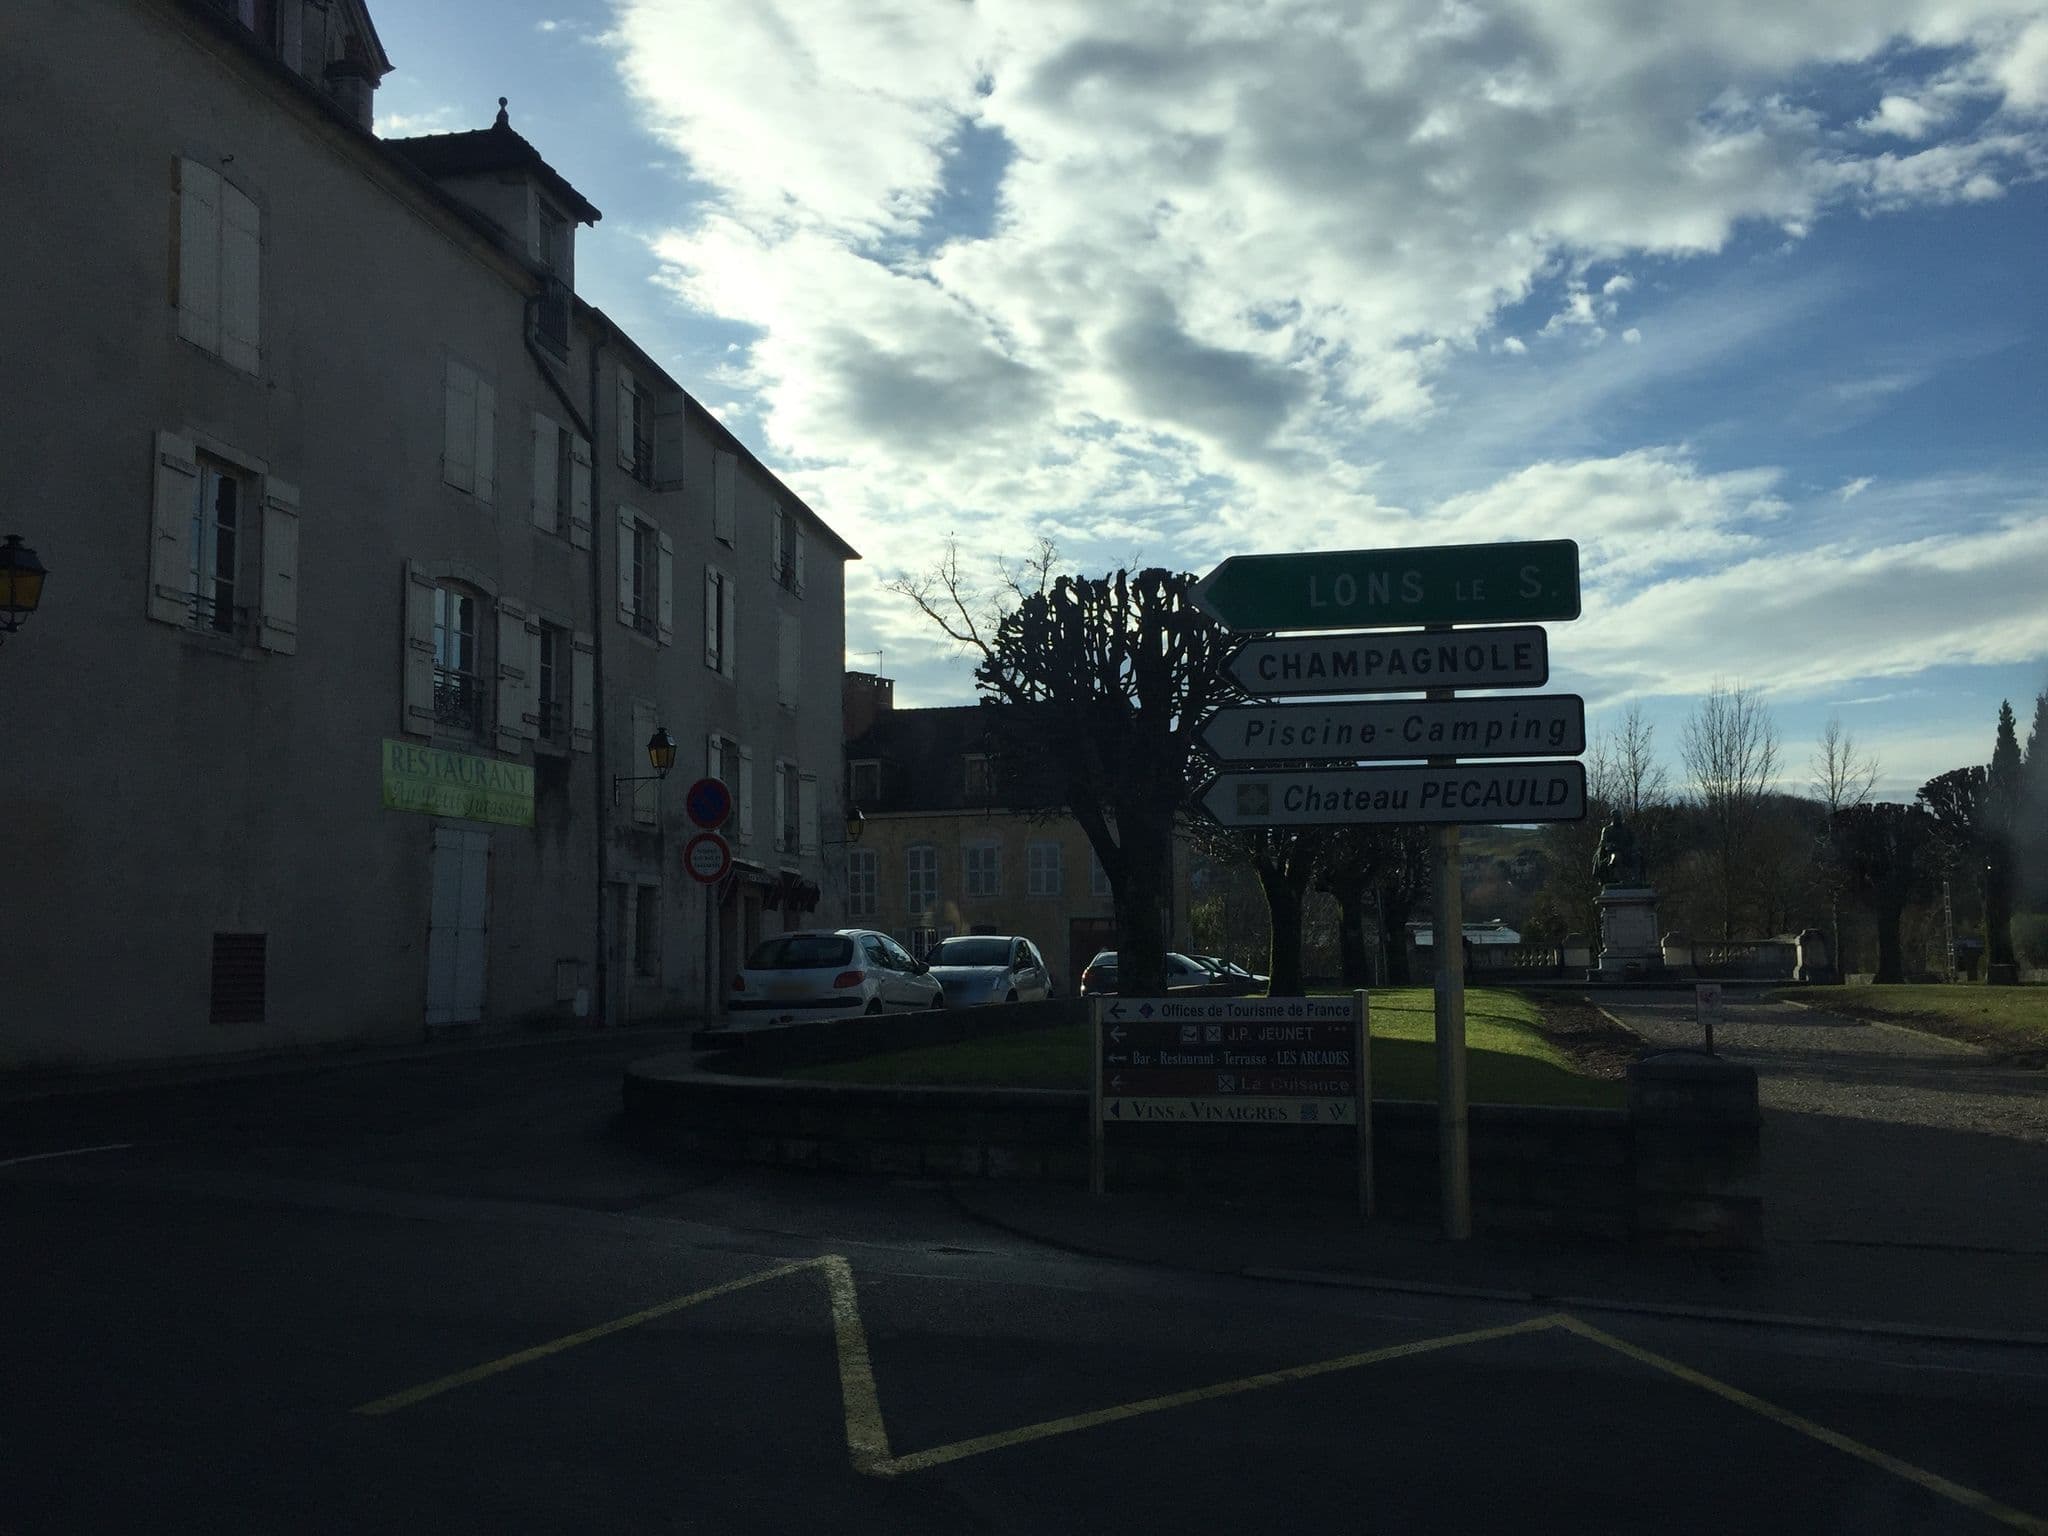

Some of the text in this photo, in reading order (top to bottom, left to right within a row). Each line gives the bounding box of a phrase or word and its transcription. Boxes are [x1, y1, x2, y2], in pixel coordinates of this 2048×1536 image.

[1309, 564, 1558, 609] LONS LE S.
[1258, 642, 1533, 682] CHAMPAGNOLE
[391, 745, 526, 791] RESTAURANT
[1284, 778, 1570, 813] Chateau PECAULD
[1161, 1004, 1350, 1017] Offices de Tourisme de France
[1257, 1026, 1314, 1041] JEUNET
[1132, 1052, 1151, 1065] Bar
[1160, 1051, 1214, 1065] Restaurant
[1223, 1051, 1267, 1066] Terrasse
[1277, 1051, 1296, 1065] LES
[1299, 1051, 1349, 1066] ARCADES
